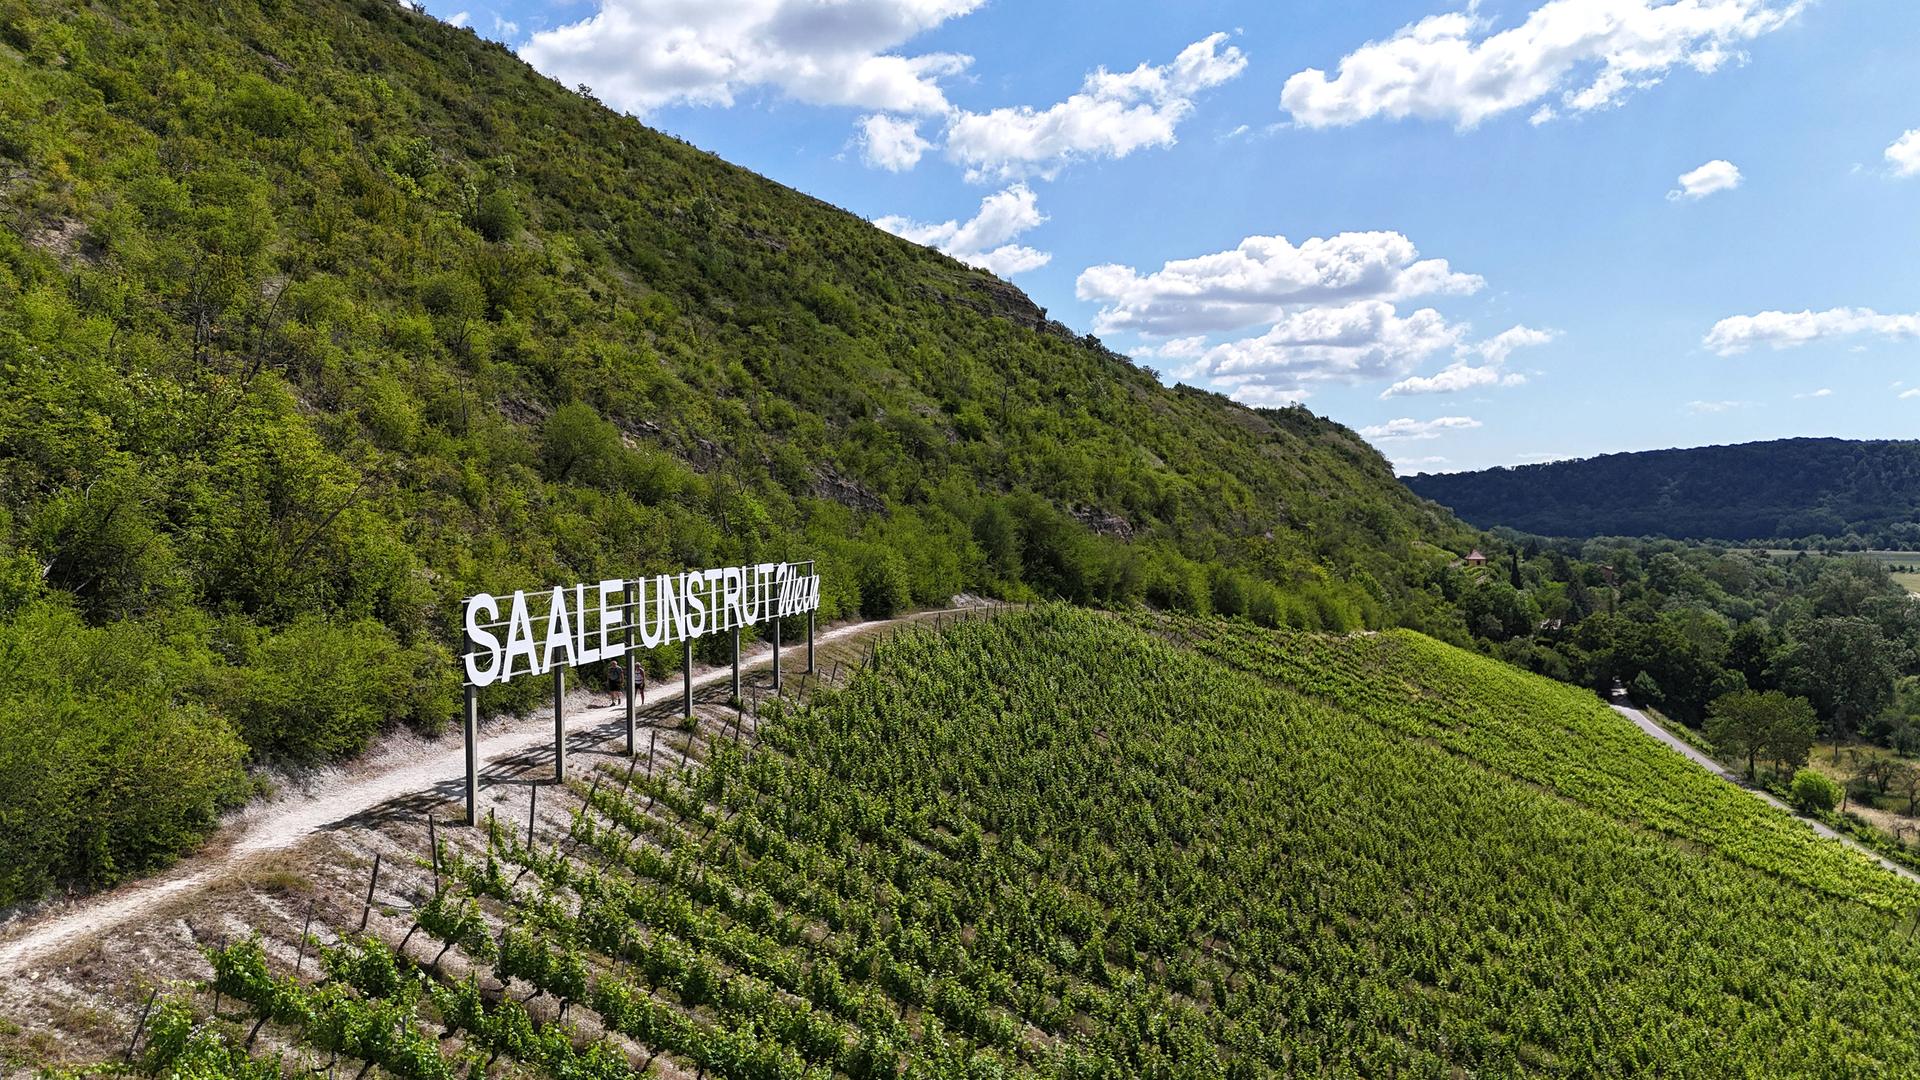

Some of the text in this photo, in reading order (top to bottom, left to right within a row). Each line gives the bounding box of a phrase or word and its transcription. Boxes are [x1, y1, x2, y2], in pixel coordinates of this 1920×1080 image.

[465, 562, 820, 687] SAALE UNSTRUT Wein
